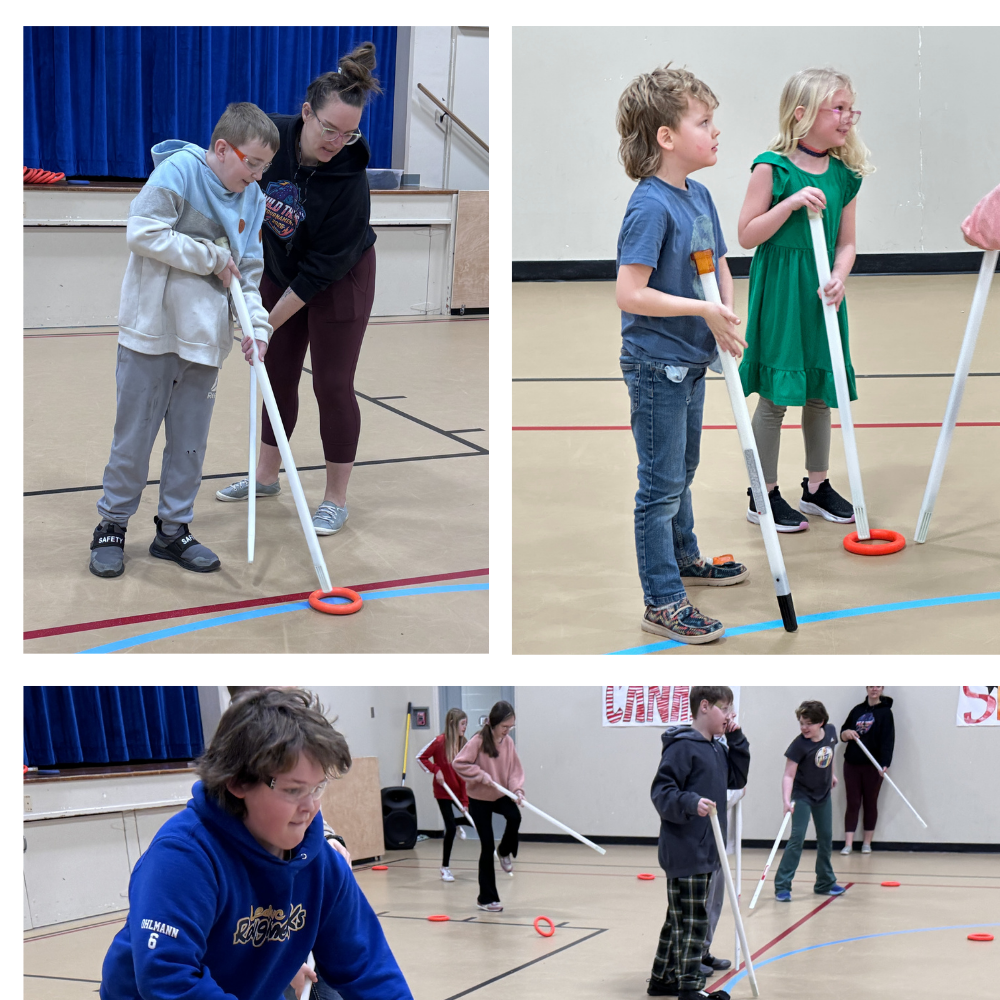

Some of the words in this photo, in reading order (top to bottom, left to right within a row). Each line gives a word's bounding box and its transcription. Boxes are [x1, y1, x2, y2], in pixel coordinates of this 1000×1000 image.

[98, 535, 123, 544] SAFETY
[140, 918, 179, 938] OHLMANN
[147, 933, 159, 950] 6
